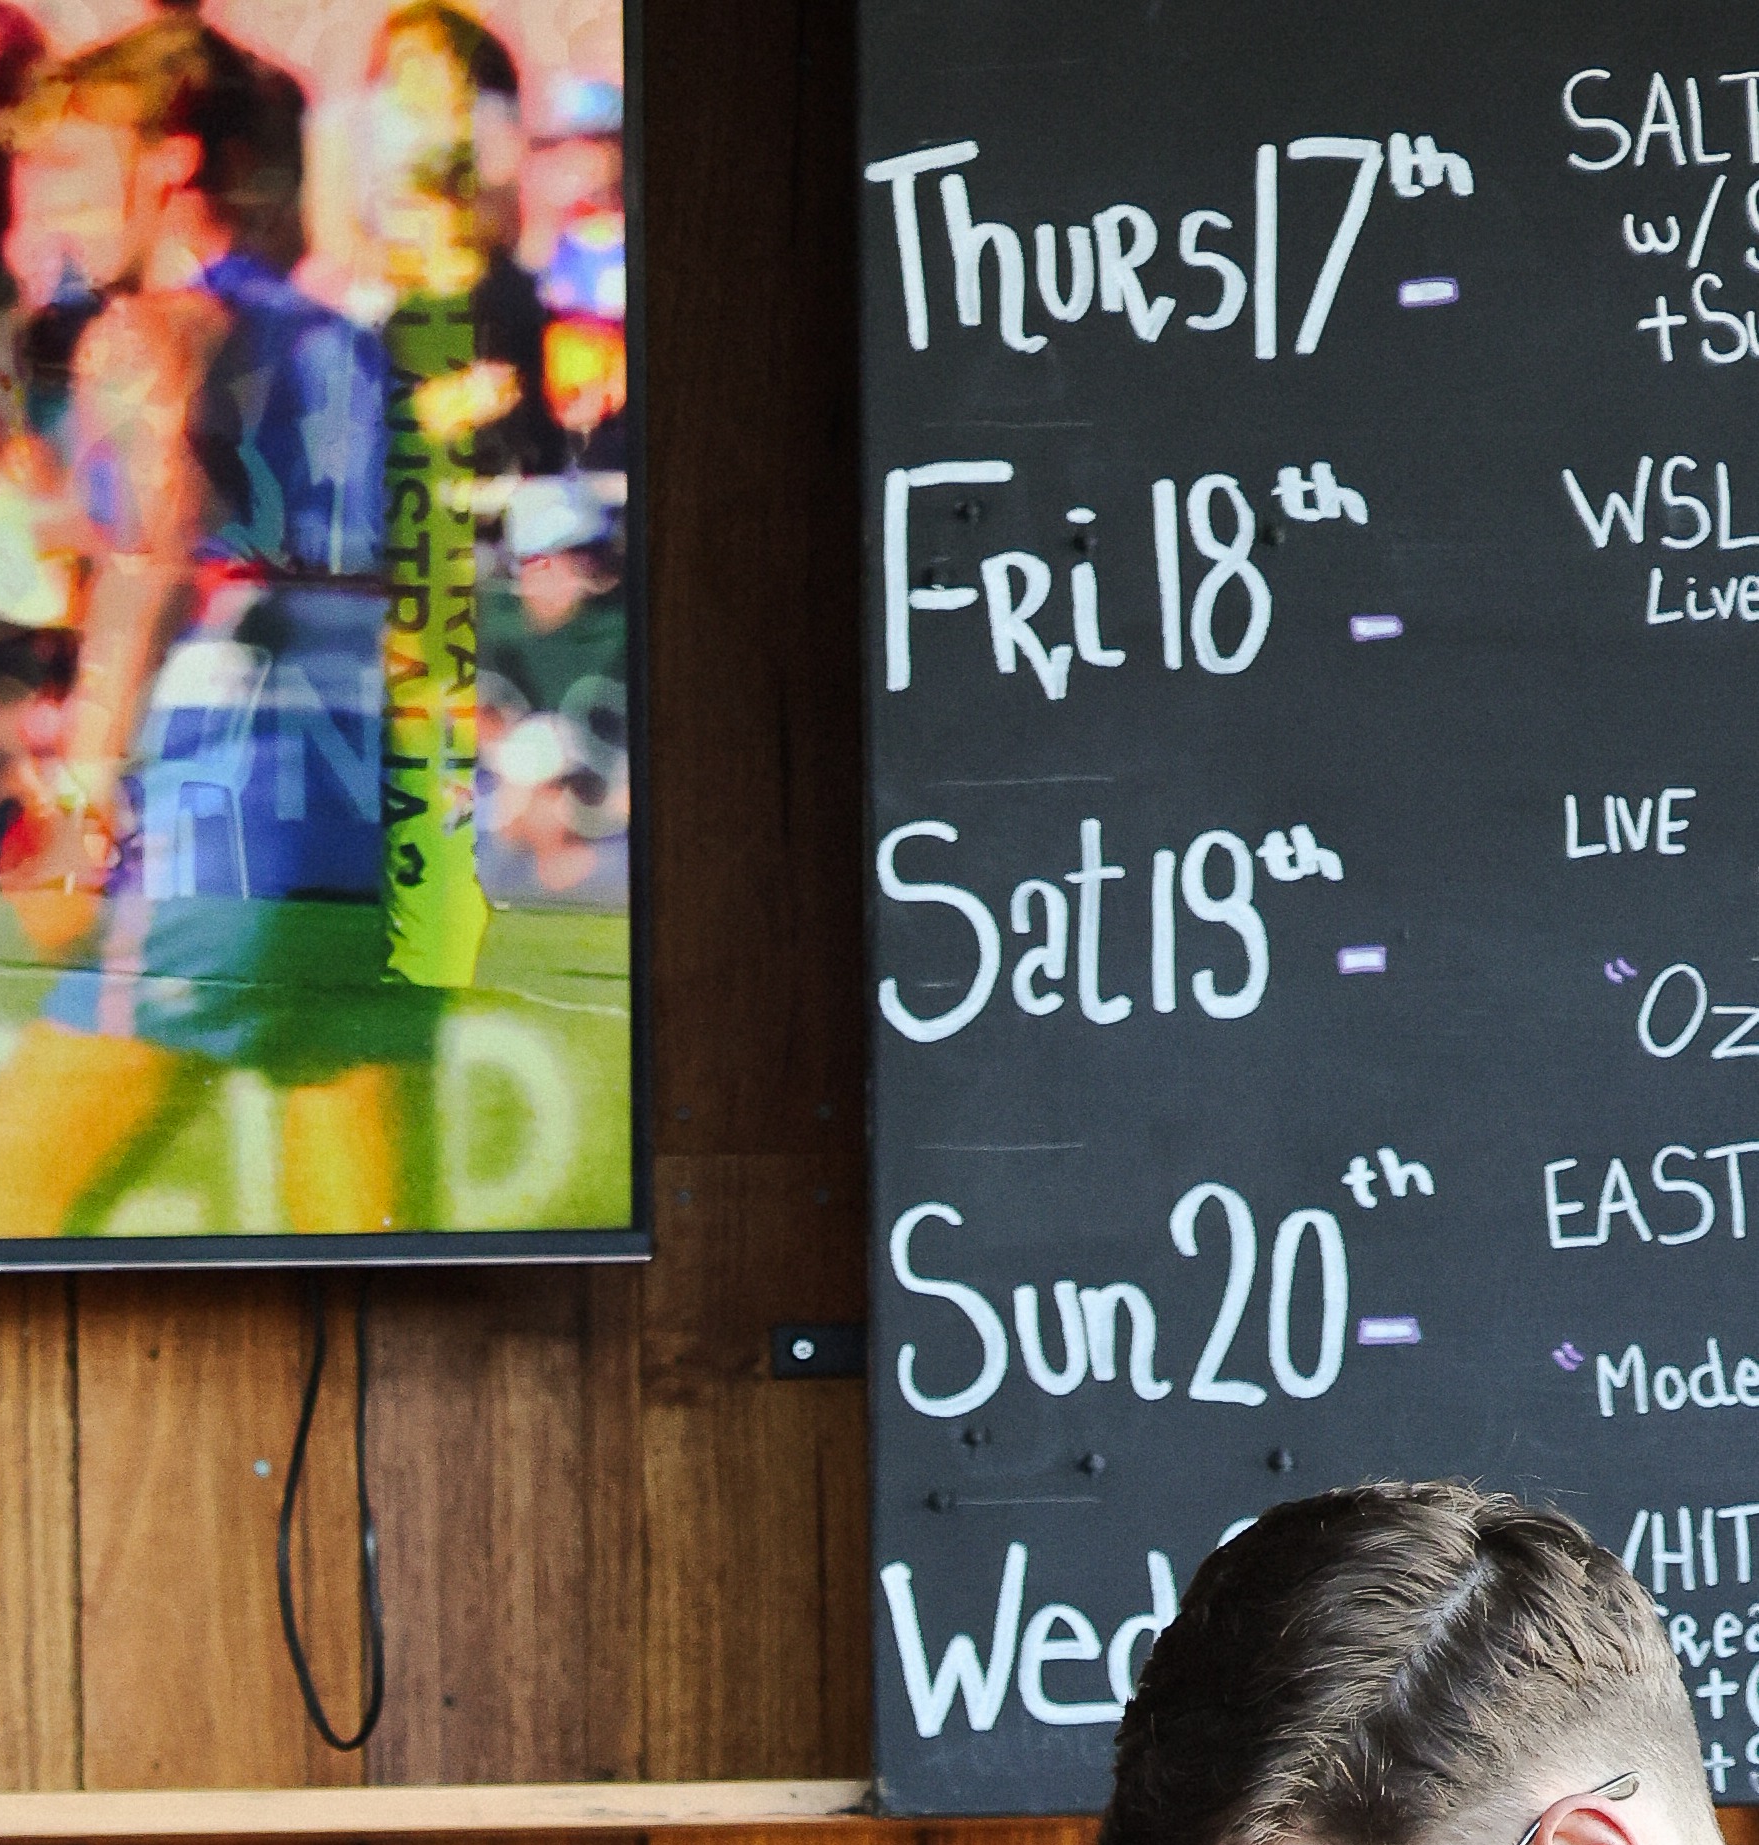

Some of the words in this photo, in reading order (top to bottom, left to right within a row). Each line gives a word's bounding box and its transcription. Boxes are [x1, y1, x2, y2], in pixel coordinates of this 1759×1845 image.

[1560, 455, 1759, 550] WSL
[1564, 786, 1697, 859] LIVE
[876, 817, 1133, 1042] Sat
[1544, 1141, 1759, 1248] EAST
[890, 1202, 1173, 1418] Sun
